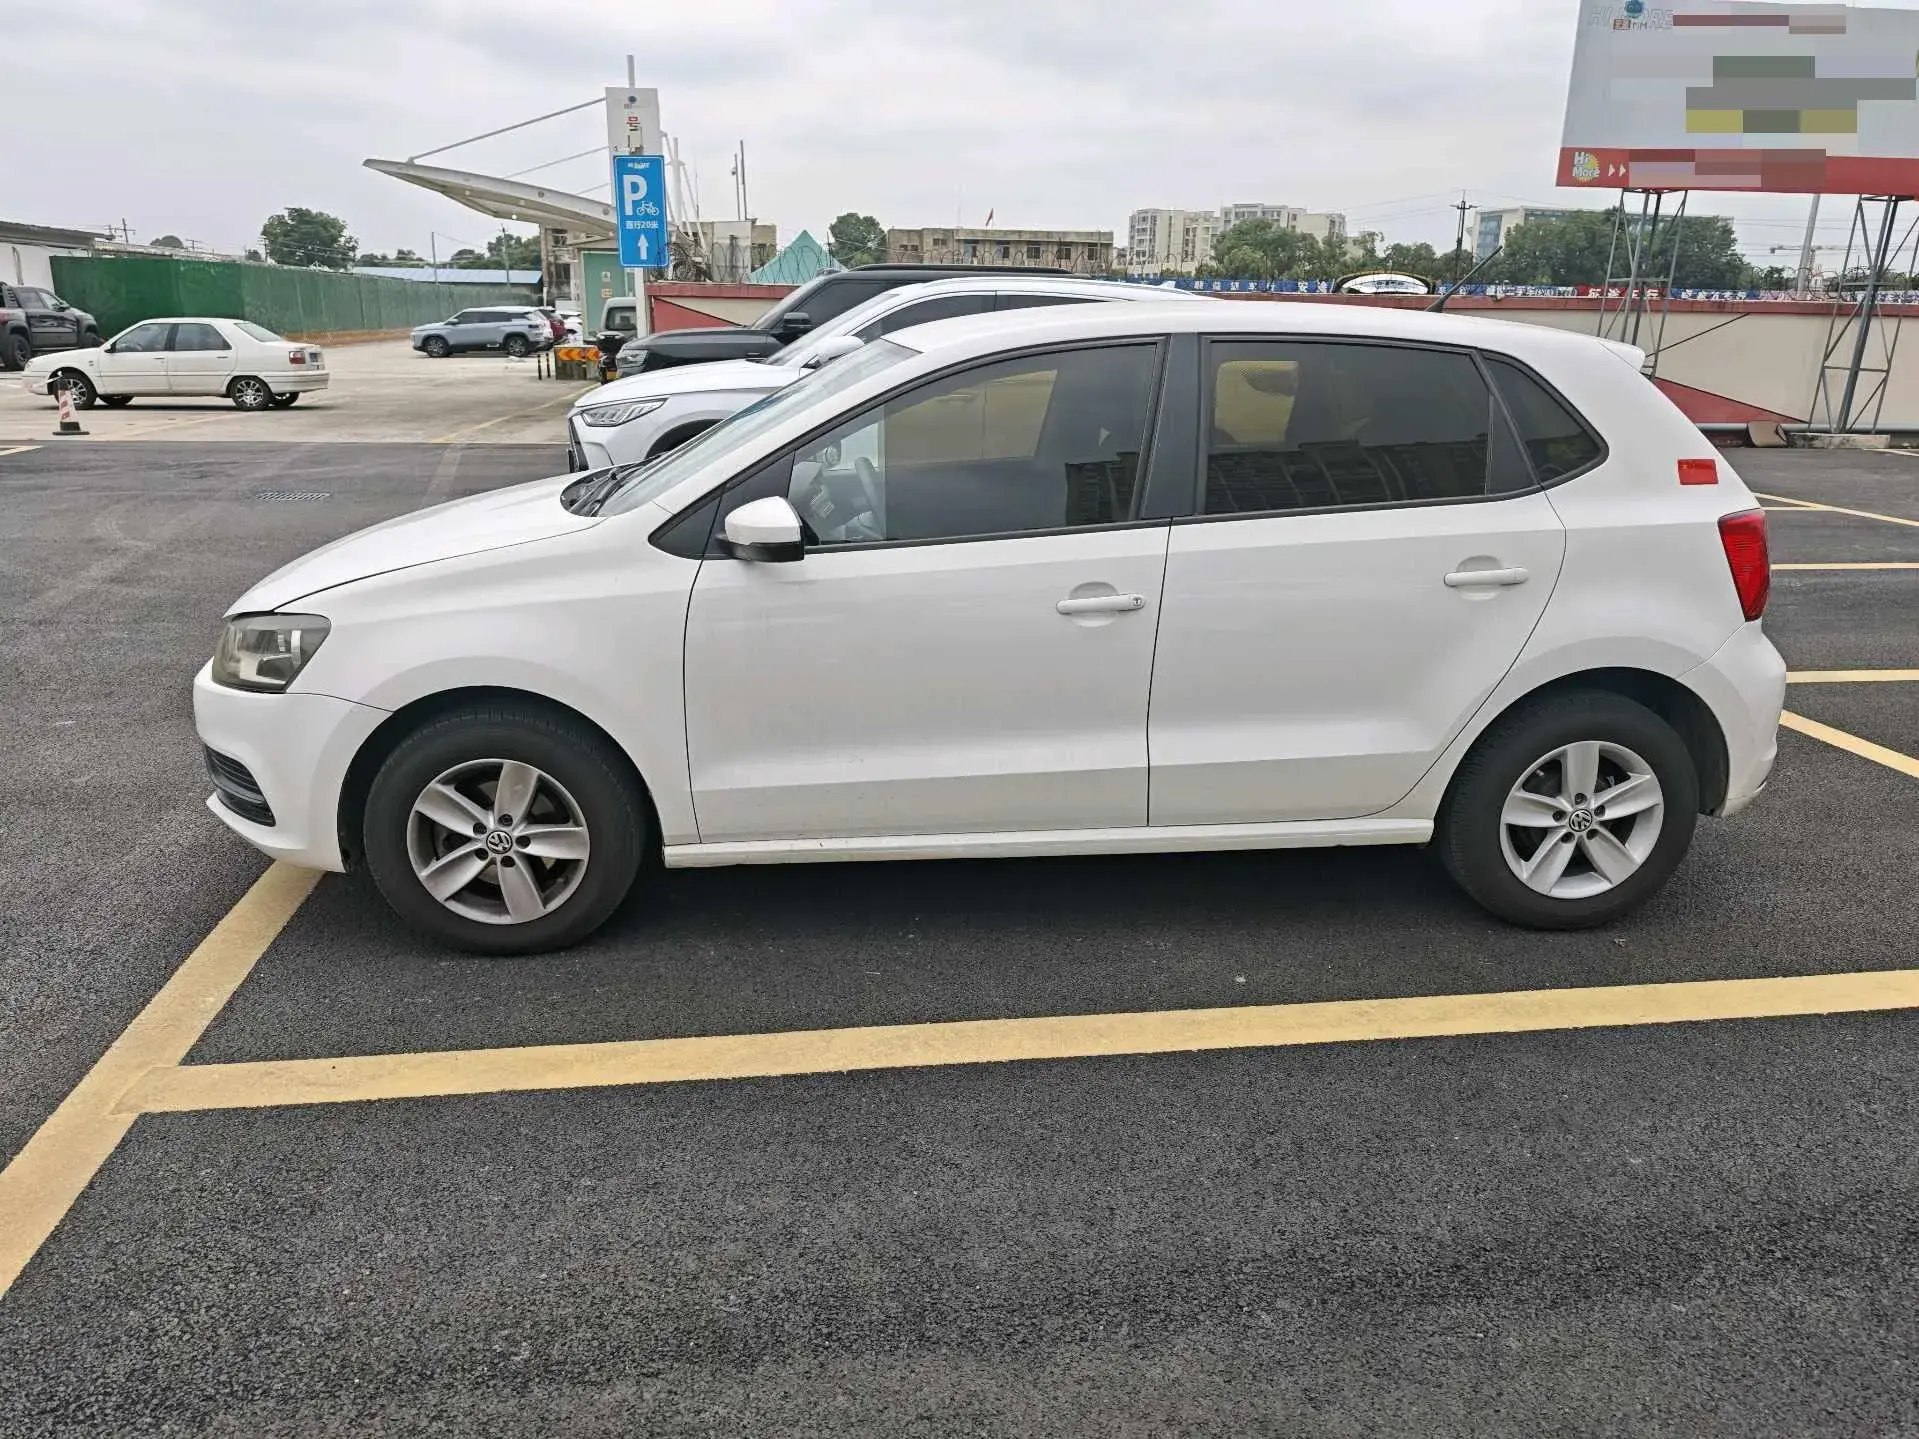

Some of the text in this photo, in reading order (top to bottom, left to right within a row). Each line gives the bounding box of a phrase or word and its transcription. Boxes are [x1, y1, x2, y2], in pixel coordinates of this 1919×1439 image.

[1574, 151, 1589, 165] Hi
[1572, 166, 1600, 177] More
[623, 174, 648, 216] P
